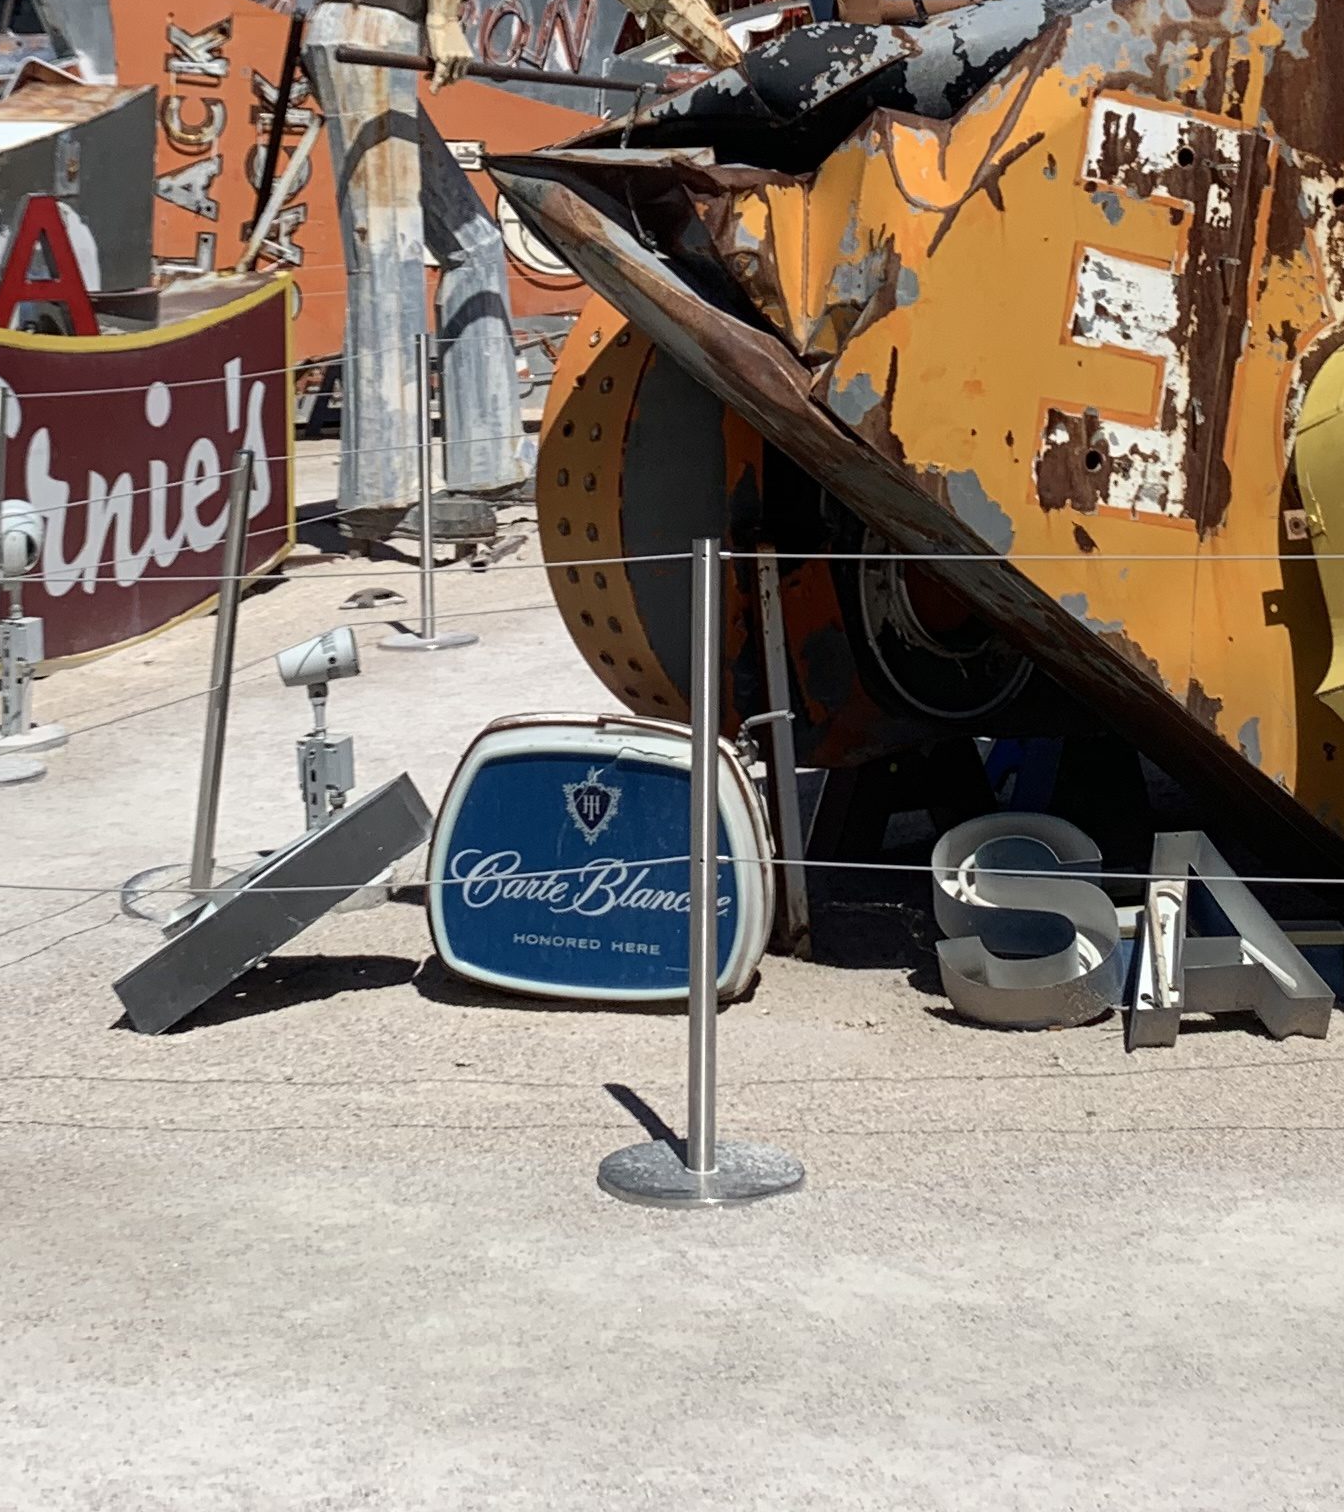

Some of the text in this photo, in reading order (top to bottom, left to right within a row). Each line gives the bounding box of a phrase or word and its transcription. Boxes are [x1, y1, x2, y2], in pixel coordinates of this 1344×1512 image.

[451, 848, 732, 916] Carte Blance
[513, 933, 661, 956] HONORED HERE
